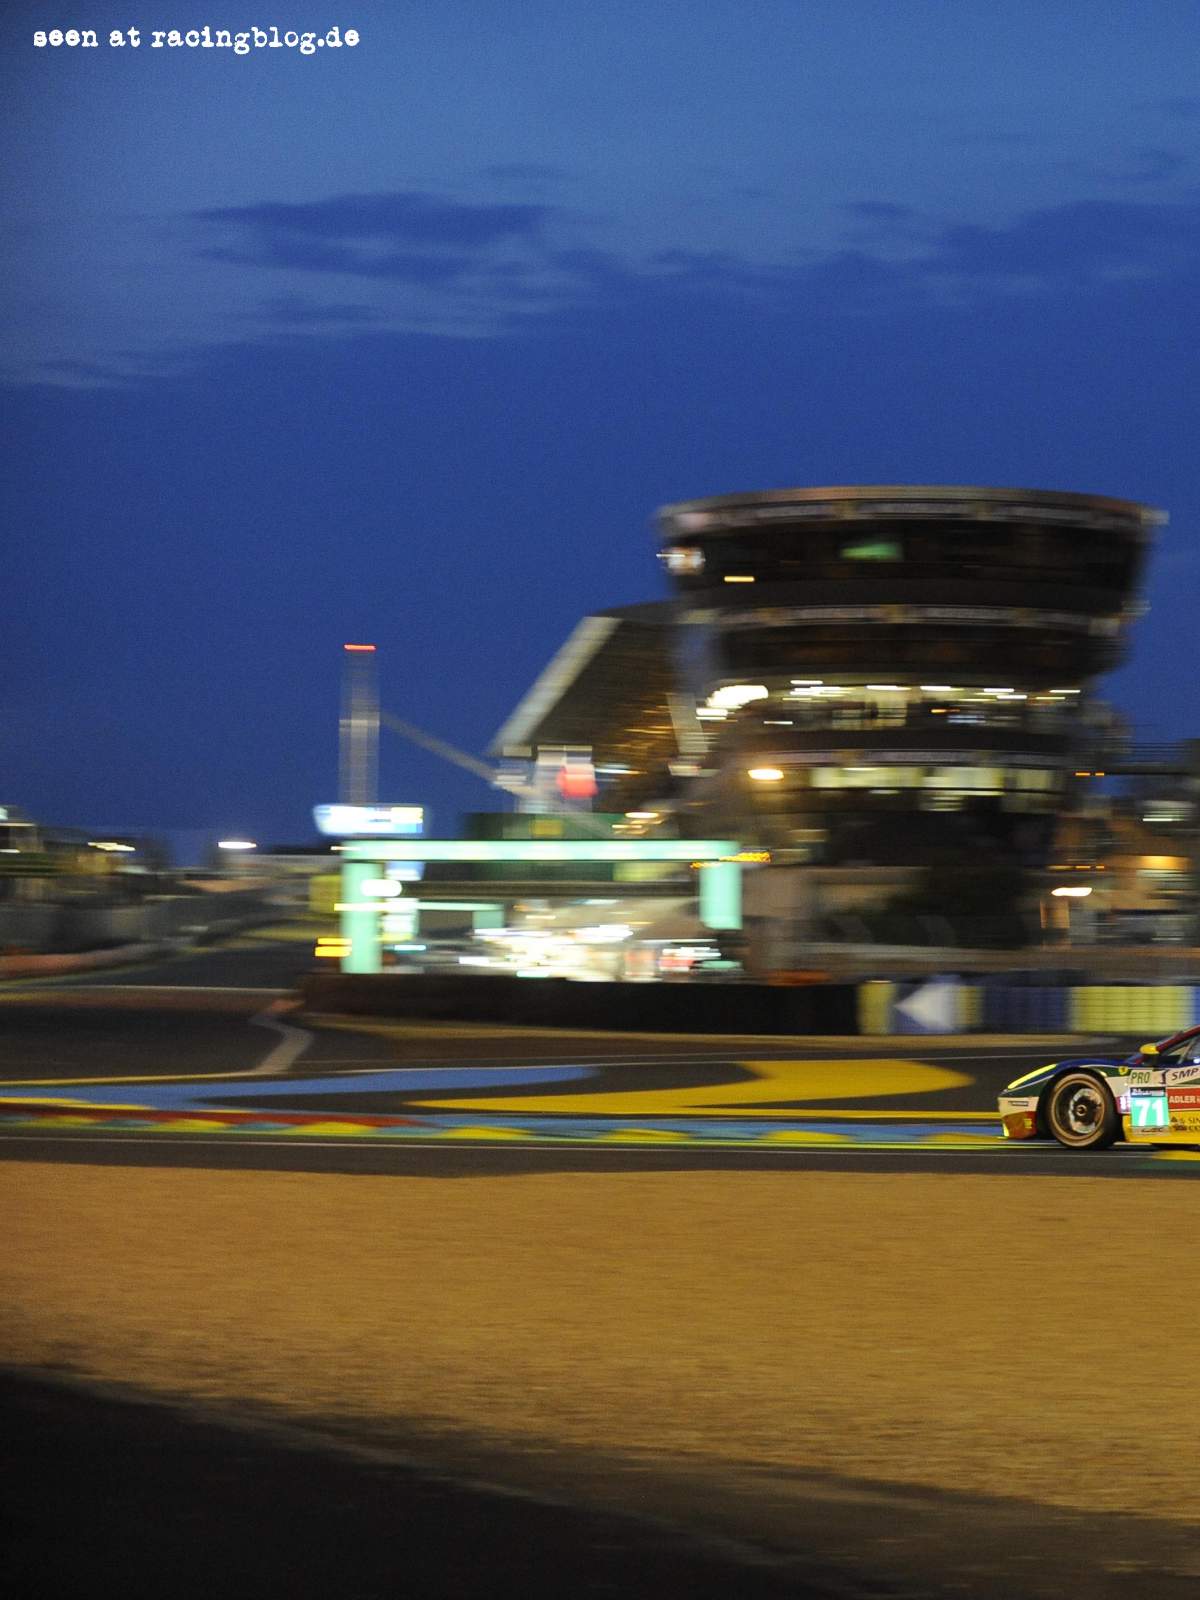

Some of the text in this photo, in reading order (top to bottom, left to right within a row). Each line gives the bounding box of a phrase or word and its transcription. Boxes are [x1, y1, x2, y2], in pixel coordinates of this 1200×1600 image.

[1131, 1072, 1151, 1084] PRO
[1171, 1067, 1199, 1081] SMP
[1169, 1095, 1196, 1104] ADLER
[1135, 1099, 1163, 1127] 71
